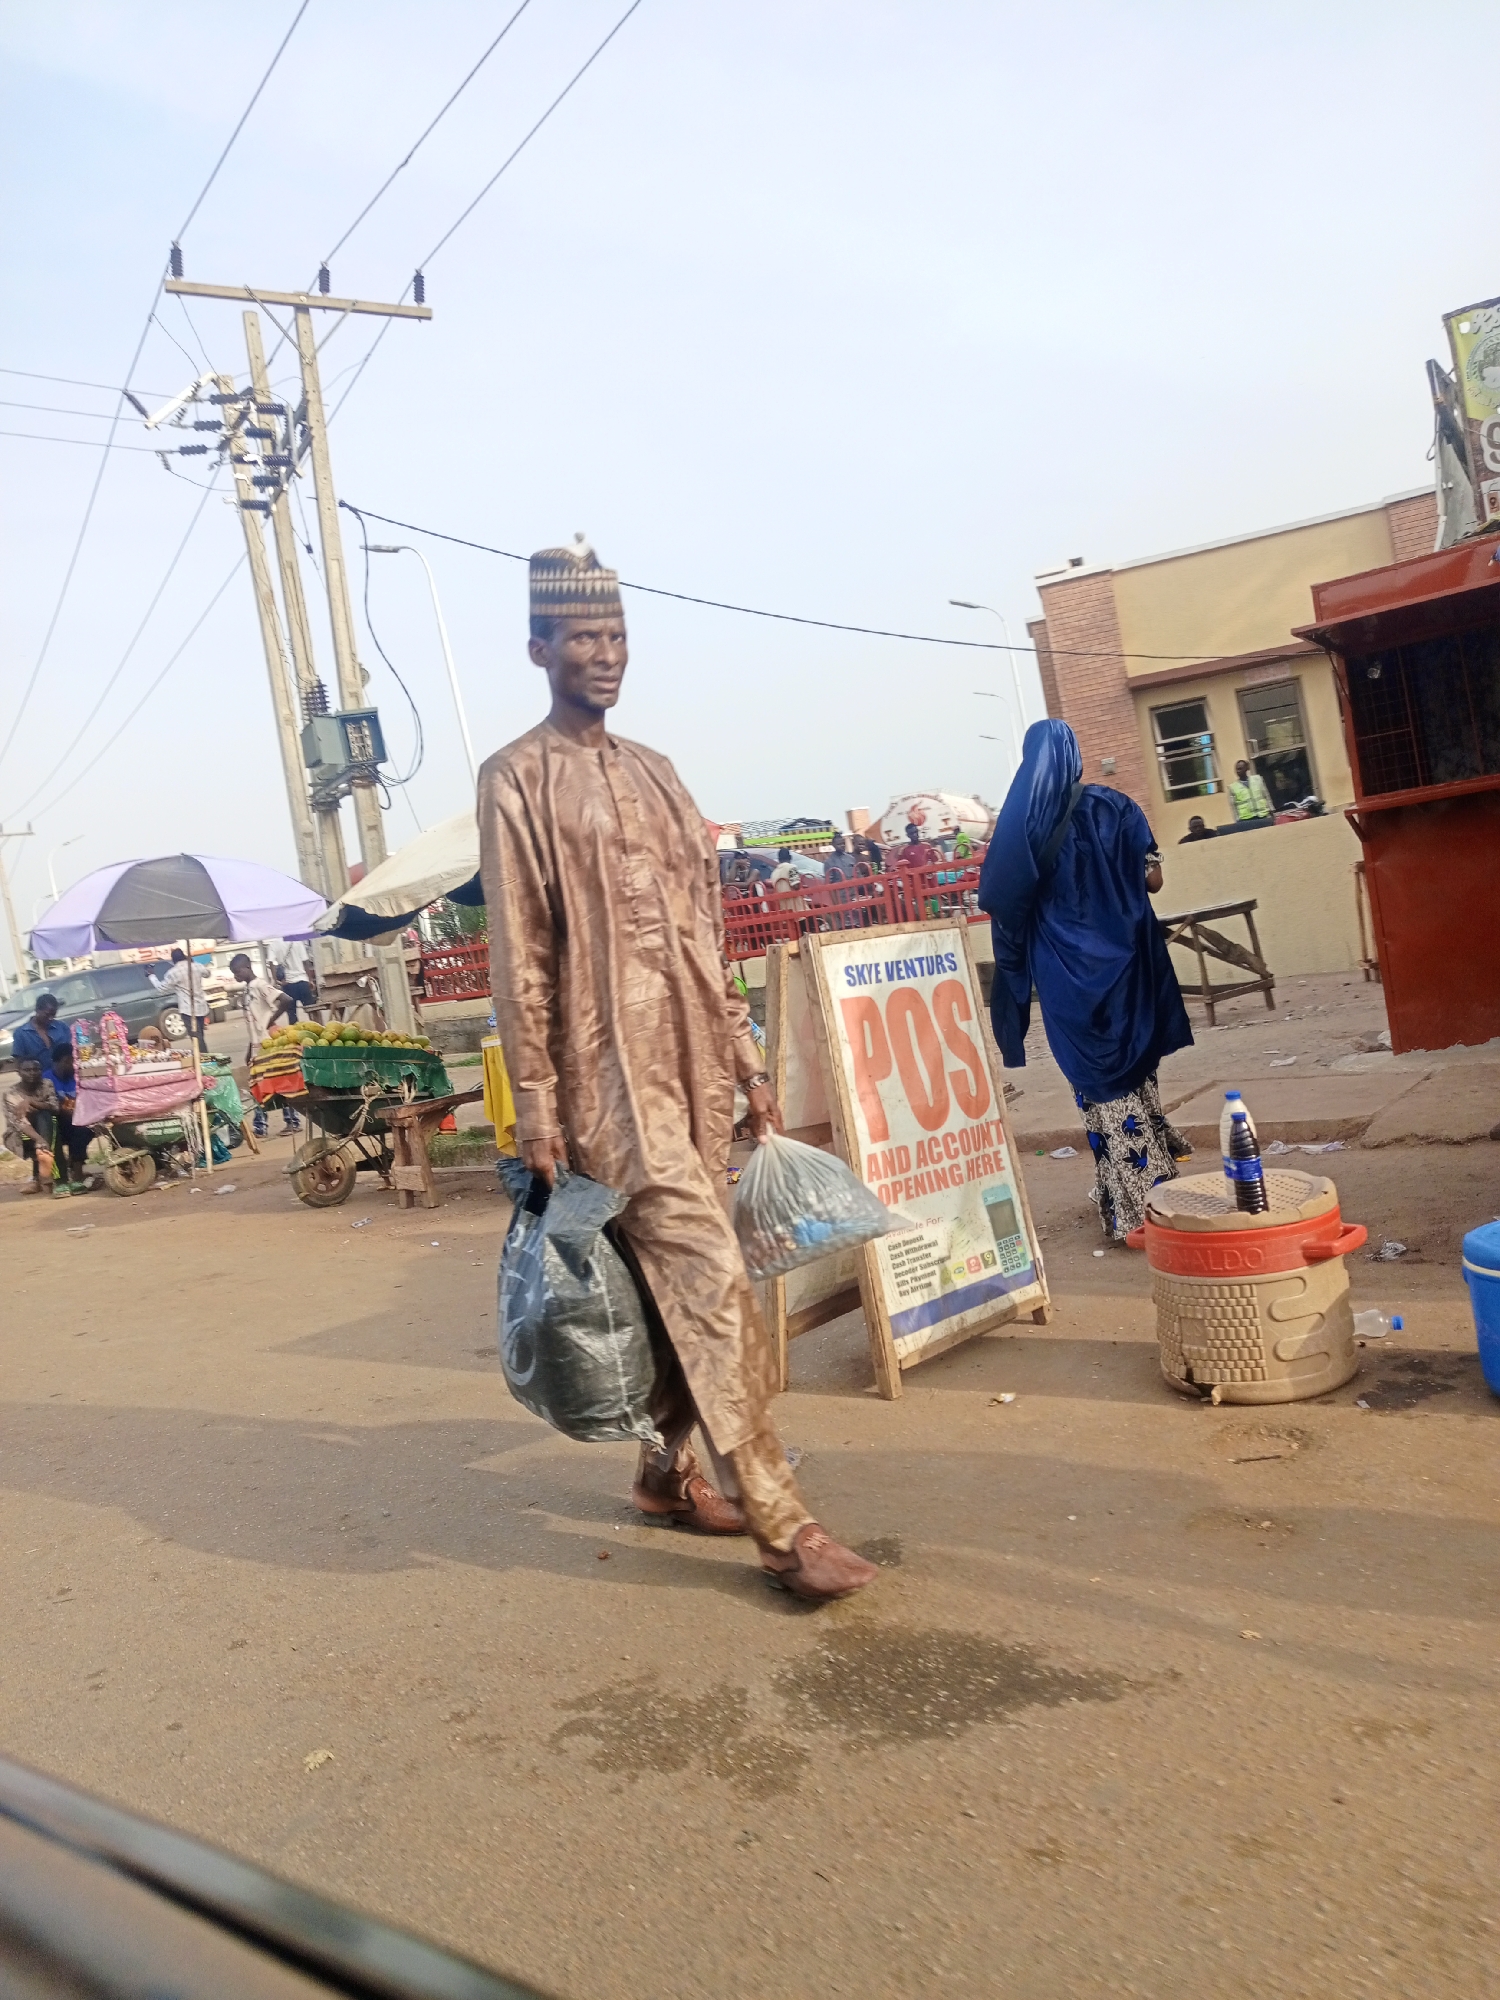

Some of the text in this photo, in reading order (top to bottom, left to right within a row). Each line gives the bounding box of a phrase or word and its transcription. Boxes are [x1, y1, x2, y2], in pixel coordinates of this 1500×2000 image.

[844, 952, 958, 987] SKYE VENTURS
[840, 979, 990, 1143] POS
[866, 1119, 1006, 1183] AND ACCOUNT
[877, 1149, 1006, 1207] OPENING HERE
[888, 1235, 924, 1251] Cash Deposit
[890, 1240, 938, 1260] Cash Withdrawal
[892, 1252, 931, 1269] Cash Transfer
[894, 1266, 918, 1279] Decoder
